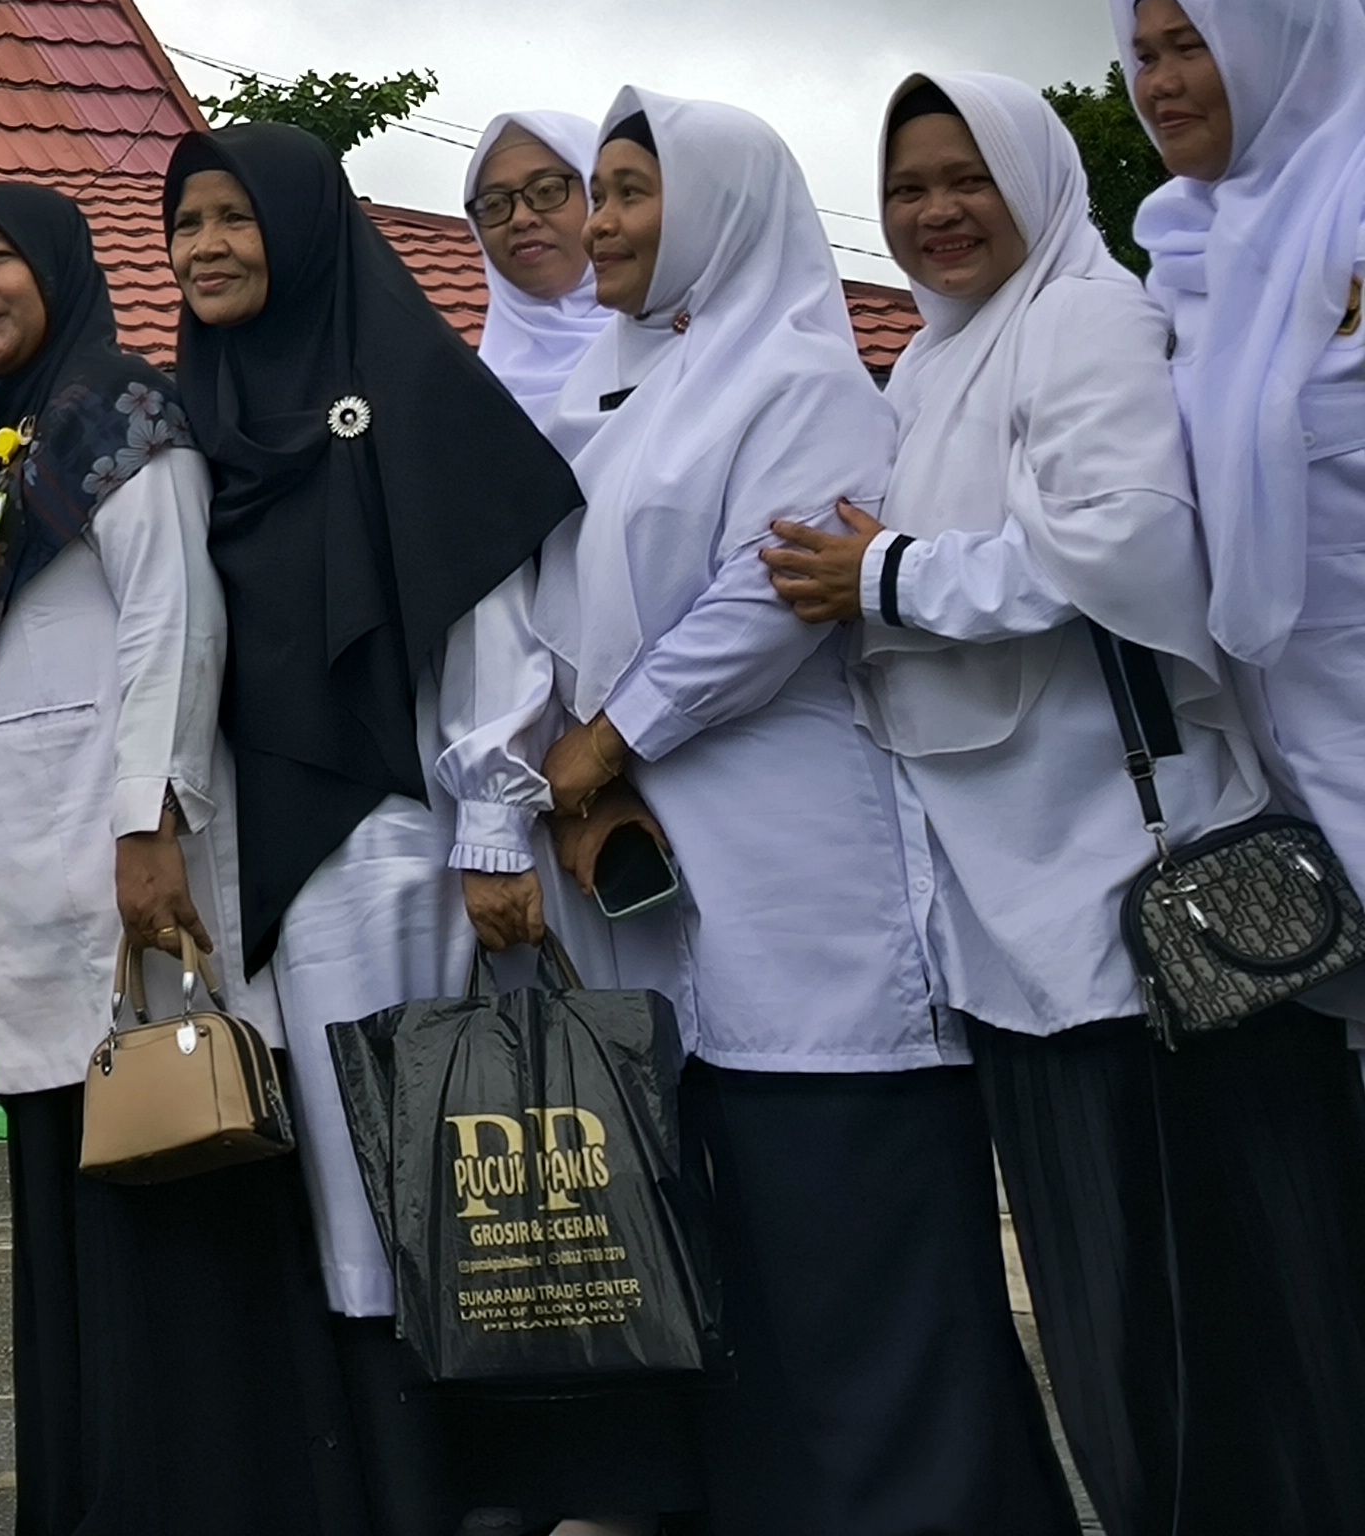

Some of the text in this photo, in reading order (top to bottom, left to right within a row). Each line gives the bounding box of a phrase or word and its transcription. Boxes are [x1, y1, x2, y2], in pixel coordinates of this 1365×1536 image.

[458, 1278, 641, 1307] SUKARAMAI TRADE CENTER
[459, 1307, 507, 1321] LANTAI
[482, 1312, 626, 1332] PEKANBARU
